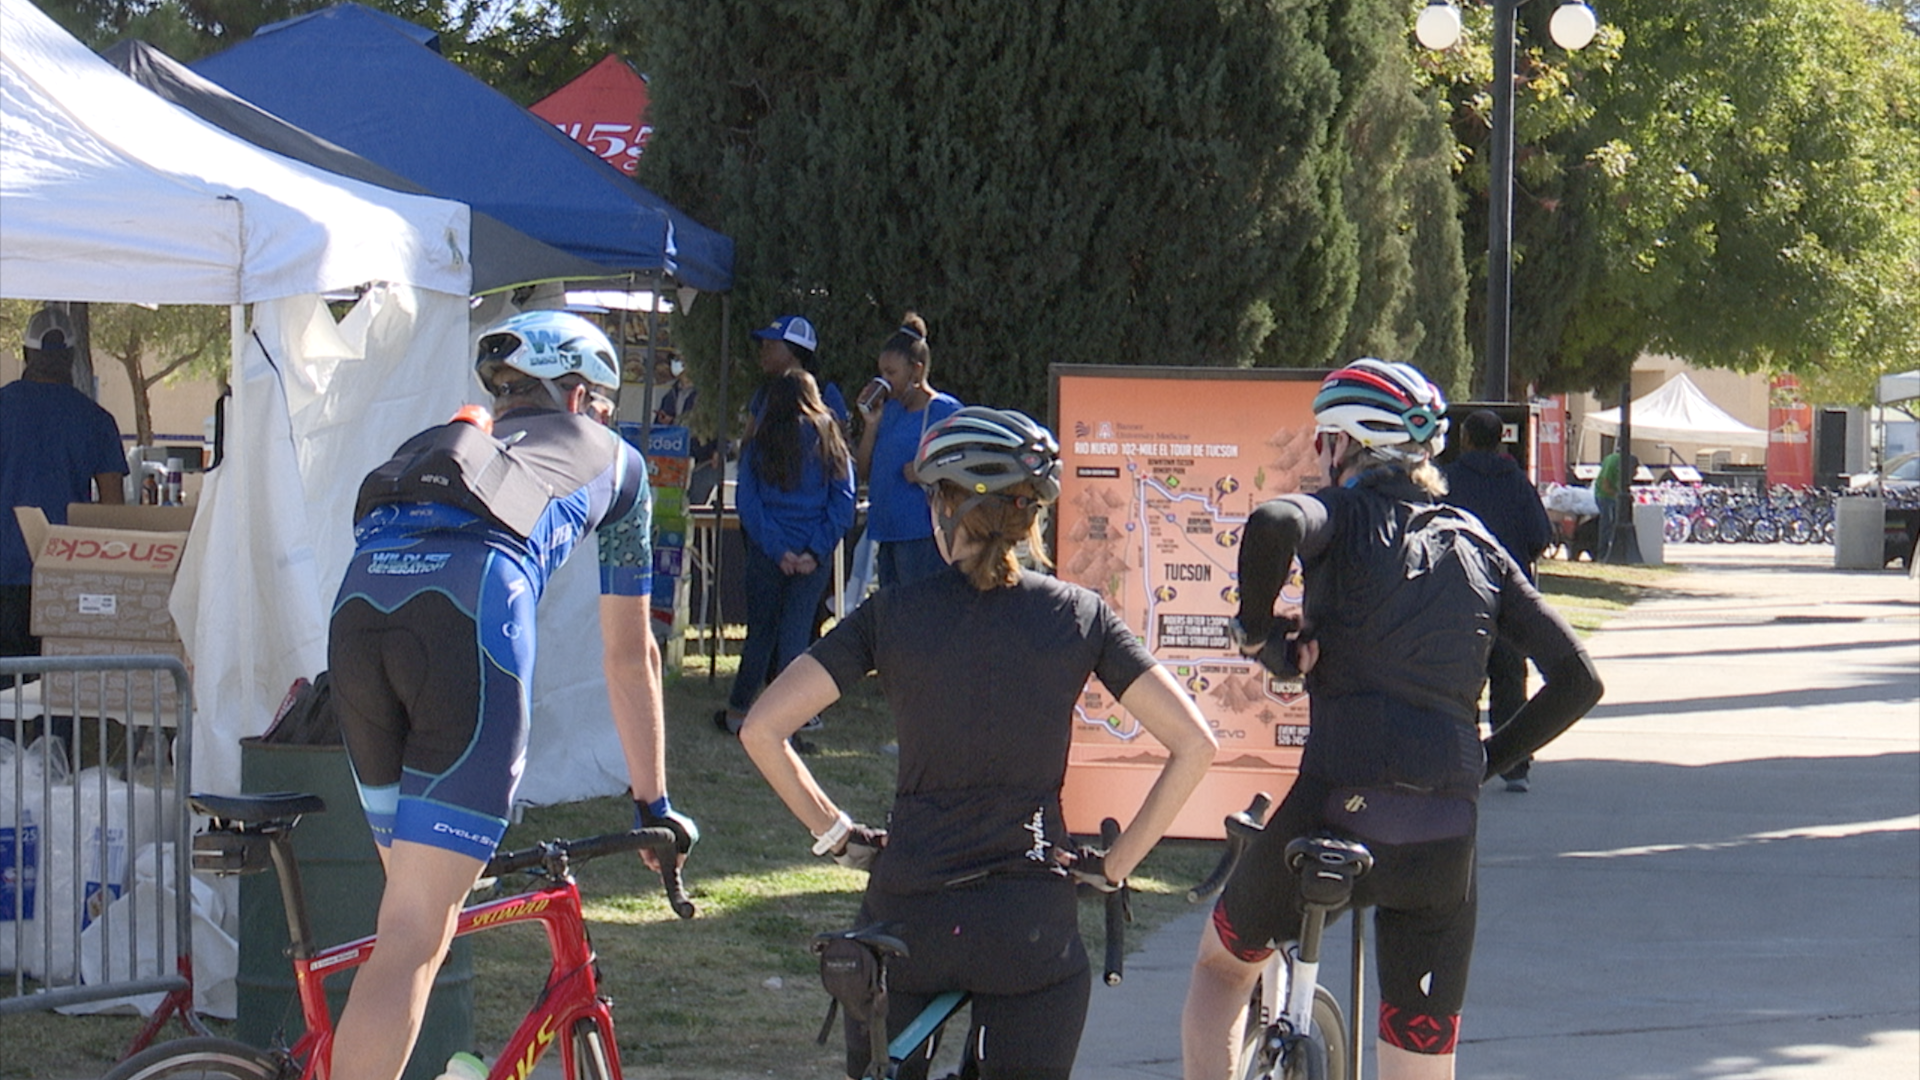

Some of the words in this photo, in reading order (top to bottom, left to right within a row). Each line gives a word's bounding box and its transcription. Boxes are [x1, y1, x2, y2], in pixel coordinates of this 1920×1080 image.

[1116, 431, 1155, 440] University
[1156, 432, 1191, 440] Medicine
[1074, 442, 1089, 455] RIO
[1090, 442, 1118, 455] NUEVO
[1121, 443, 1158, 456] 102-MILE
[1159, 444, 1169, 456] EL
[1170, 444, 1192, 457] TOUR
[1193, 445, 1204, 457] DE
[1205, 445, 1239, 457] TUCSON
[56, 538, 178, 562] snack
[1164, 563, 1212, 582] TUCSON
[1163, 615, 1186, 625] RIDERS
[1186, 615, 1206, 626] AFTER
[1166, 625, 1184, 635] MUST
[1184, 626, 1201, 636] TURN
[1202, 626, 1224, 637] NORTH
[1176, 636, 1189, 647] NOT
[1189, 636, 1209, 647] START
[1277, 725, 1297, 736] EVENT
[471, 898, 550, 928] SPECIALIZED
